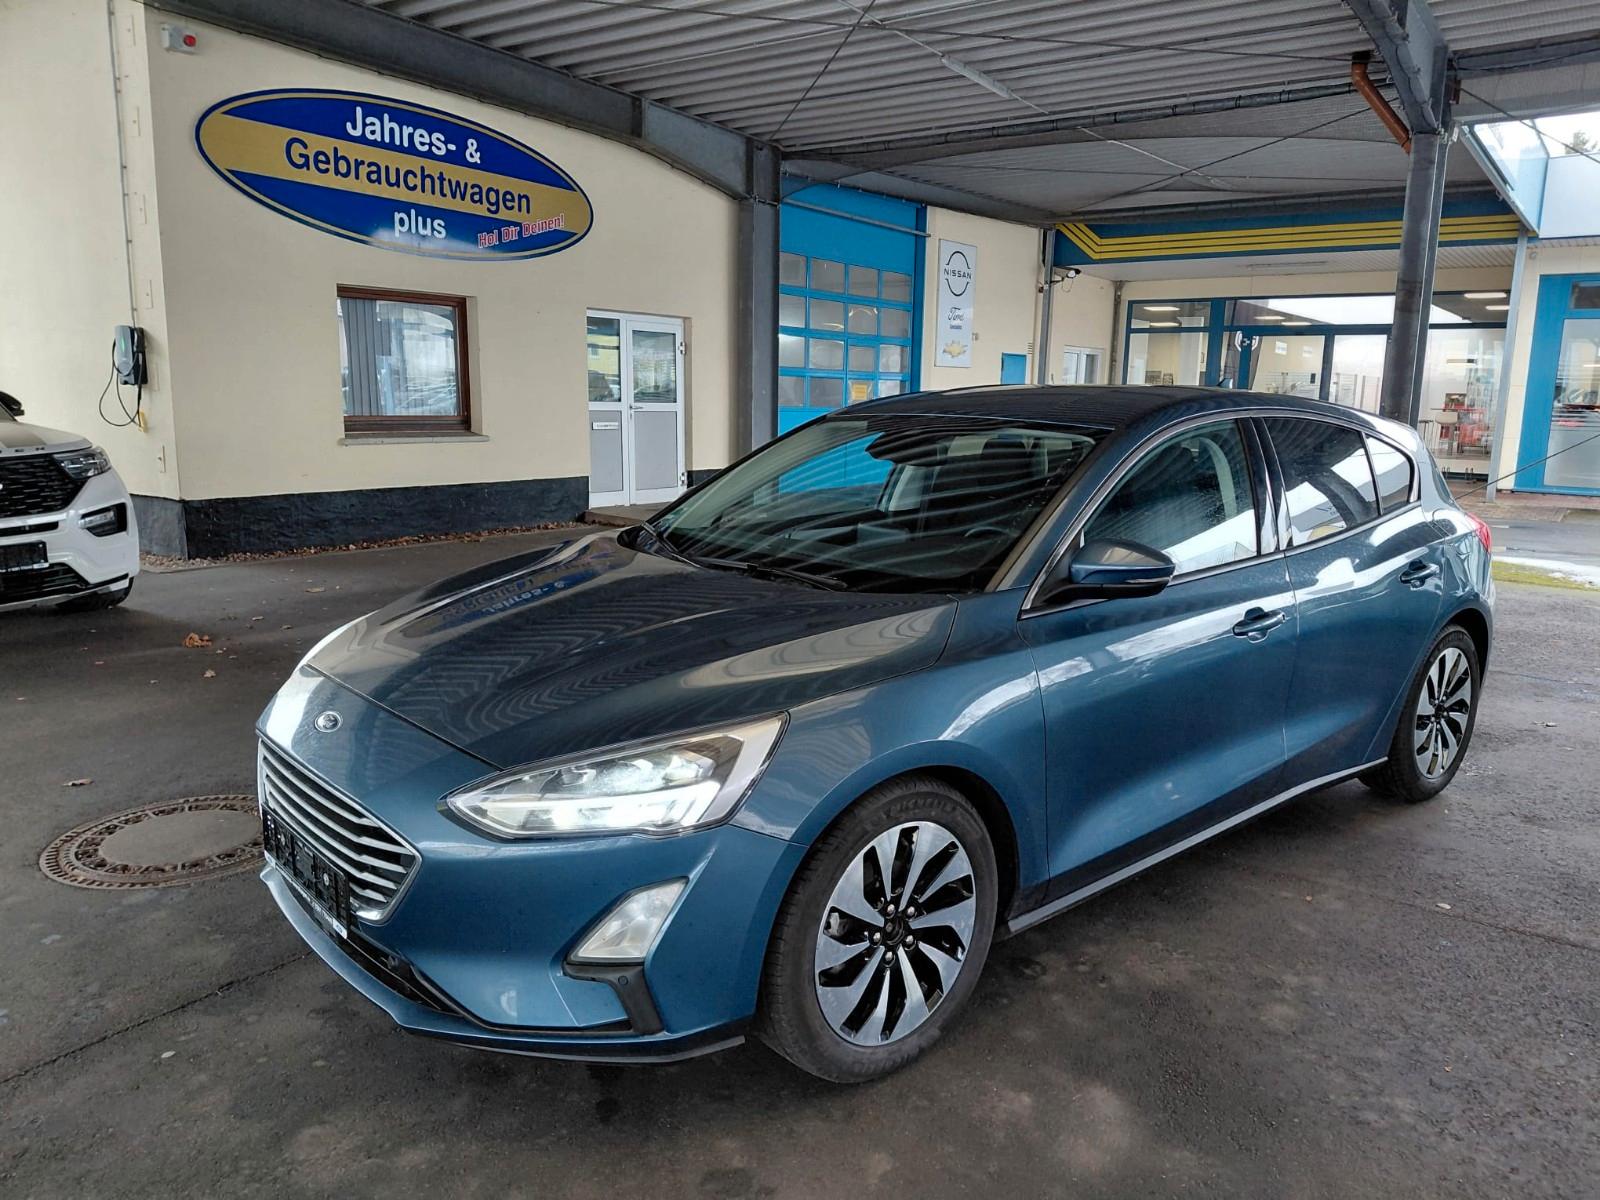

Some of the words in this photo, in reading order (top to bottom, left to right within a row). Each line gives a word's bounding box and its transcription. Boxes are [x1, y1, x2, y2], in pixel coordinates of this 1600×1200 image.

[346, 106, 457, 157] Jahres-
[466, 138, 481, 165] &
[286, 138, 531, 214] Gebrauchtwagen
[394, 210, 447, 239] plus
[478, 229, 499, 249] Hol
[501, 225, 520, 243] Dir
[522, 213, 565, 238] Deinen!
[943, 268, 971, 279] NISSAN
